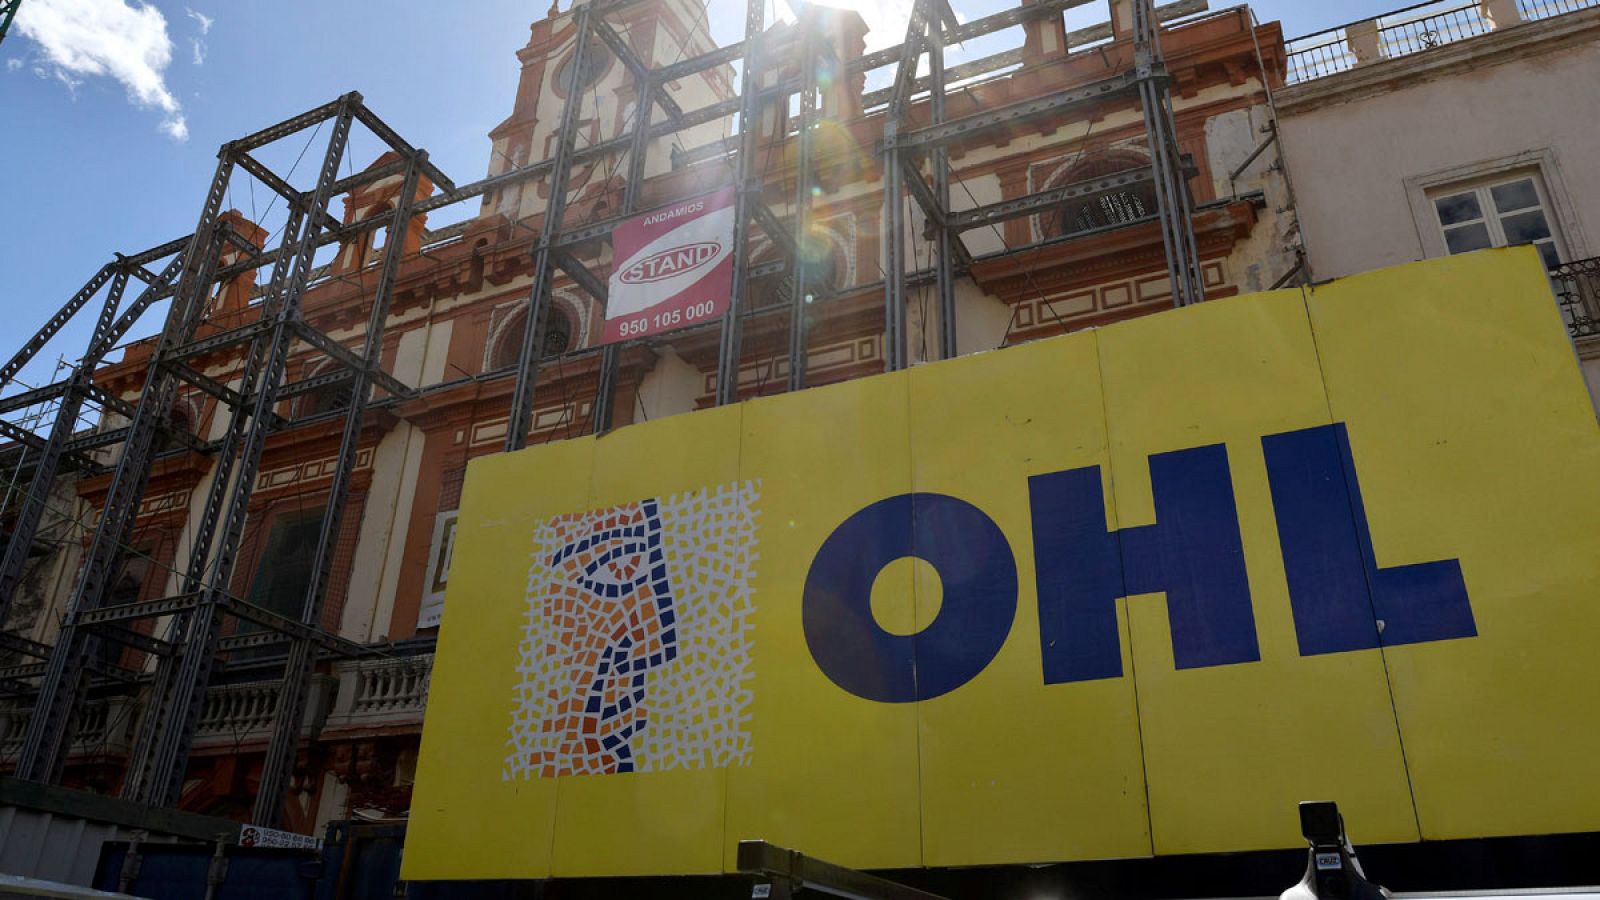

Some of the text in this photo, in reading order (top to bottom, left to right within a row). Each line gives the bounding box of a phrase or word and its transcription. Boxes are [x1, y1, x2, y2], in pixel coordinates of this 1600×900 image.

[643, 201, 704, 227] ANDAMIOS
[628, 245, 718, 281] STAND
[619, 300, 715, 337] 950 105 000
[802, 422, 1478, 703] OHL
